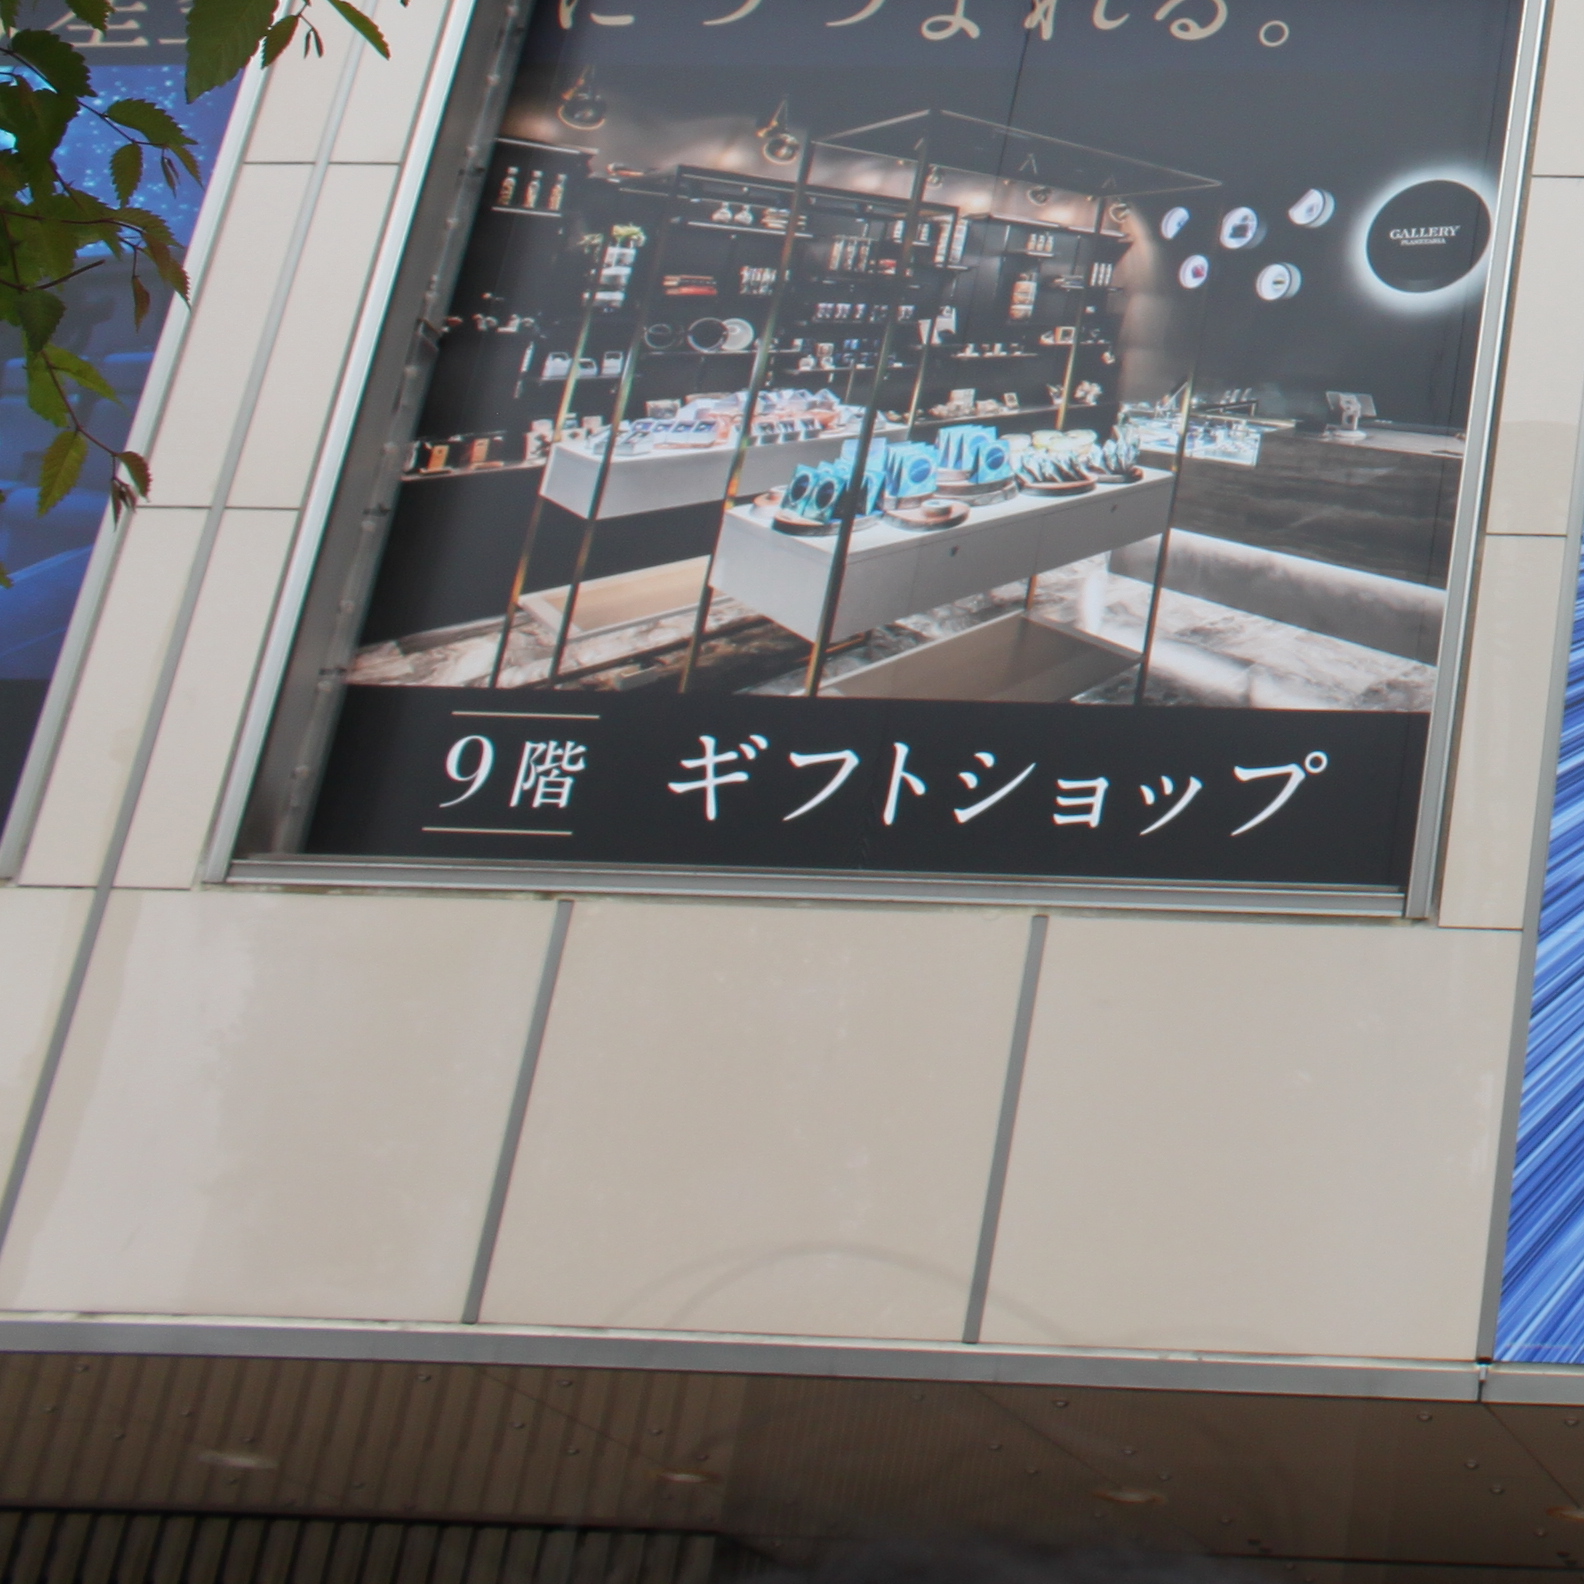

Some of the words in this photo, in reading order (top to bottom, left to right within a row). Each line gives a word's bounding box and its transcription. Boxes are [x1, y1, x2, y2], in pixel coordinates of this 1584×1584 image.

[1389, 225, 1461, 240] GALLERY
[437, 735, 588, 810] 9階
[667, 734, 1329, 837] ギフトショップ
